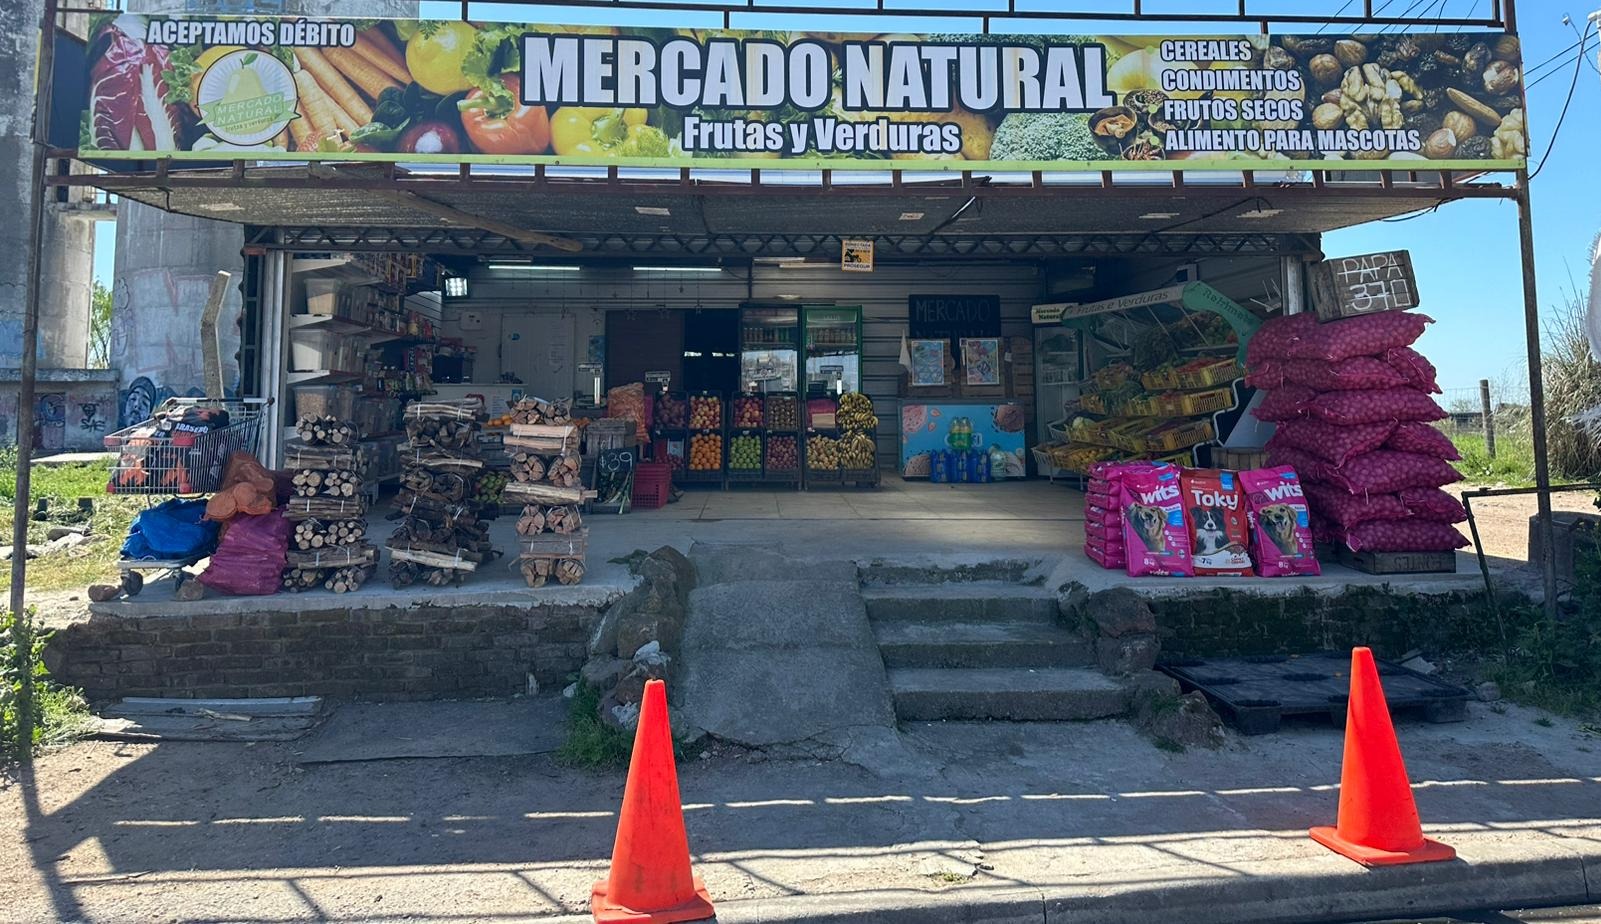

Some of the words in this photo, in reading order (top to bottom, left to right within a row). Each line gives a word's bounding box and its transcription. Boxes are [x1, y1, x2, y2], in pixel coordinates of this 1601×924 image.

[147, 20, 275, 46] ACEPTAMOS
[280, 18, 355, 47] DÉBITO
[1161, 40, 1252, 61] CEREALES
[524, 36, 828, 109] MERCADO
[845, 44, 1113, 111] NATURAL
[1162, 69, 1301, 91] CONDIMENTOS
[216, 105, 282, 125] NATURAL
[217, 95, 282, 115] MERCADO
[1164, 99, 1239, 121] FRUTOS
[1241, 99, 1304, 121] SECOS
[684, 116, 784, 150] Frutas
[791, 123, 809, 153] y
[813, 117, 961, 151] Verduras
[1165, 129, 1261, 151] ALIMENTO
[1263, 129, 1316, 151] PARA
[1317, 129, 1421, 151] MASCOTAS
[1341, 252, 1403, 284] PAPA
[1117, 290, 1169, 309] Verduras
[915, 300, 991, 323] MERCADO
[1140, 484, 1180, 505] wits
[1191, 489, 1239, 511] Toky
[1263, 480, 1304, 502] wits
